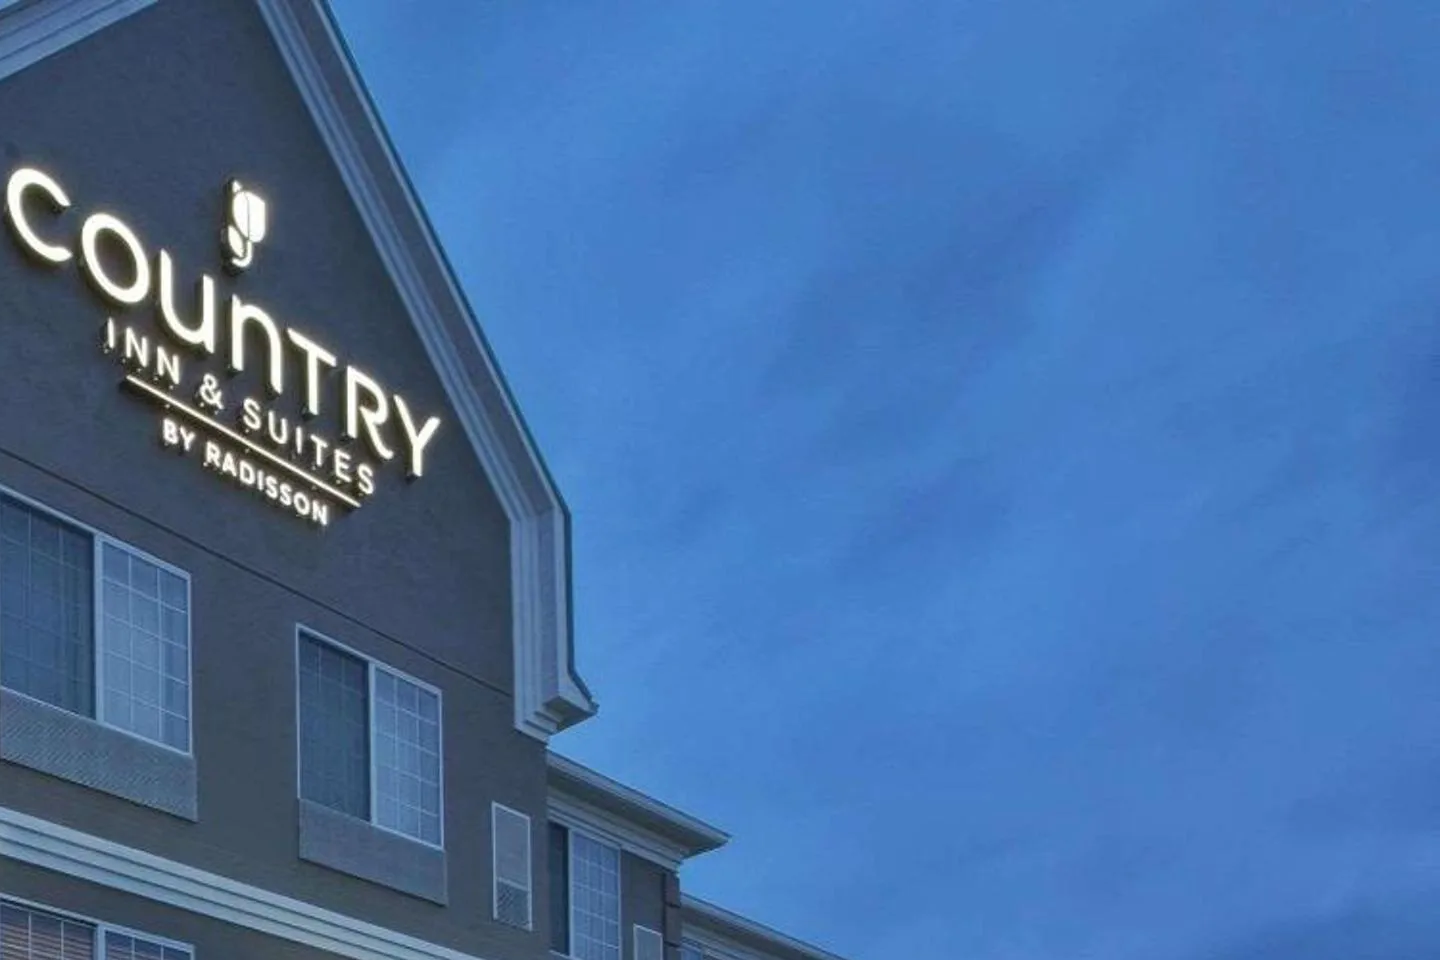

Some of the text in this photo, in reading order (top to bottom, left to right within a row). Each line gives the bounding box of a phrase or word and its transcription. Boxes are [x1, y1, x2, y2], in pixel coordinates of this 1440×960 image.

[6, 167, 441, 478] COUNTRY
[107, 316, 375, 496] INN & SUITES
[162, 418, 328, 526] BY RADISSON
